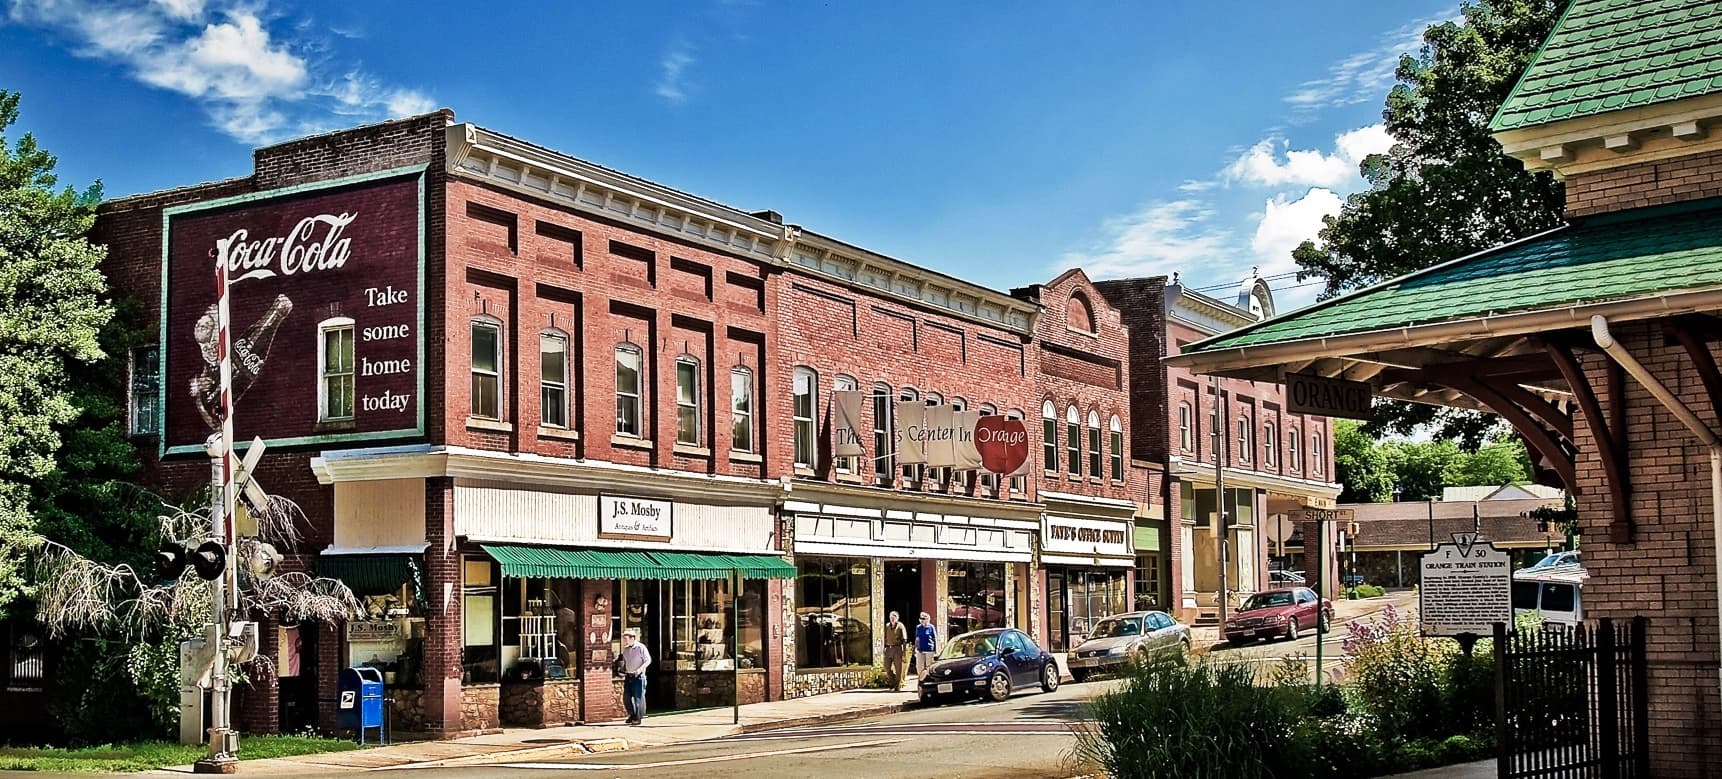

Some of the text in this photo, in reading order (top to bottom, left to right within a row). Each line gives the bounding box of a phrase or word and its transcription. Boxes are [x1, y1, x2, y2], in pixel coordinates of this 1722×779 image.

[227, 212, 357, 285] Coca-Cola
[364, 286, 408, 307] Take
[363, 324, 409, 341] some
[234, 339, 264, 375] Coca-Cola
[361, 357, 410, 376] home
[362, 390, 410, 412] today
[1293, 380, 1367, 413] ORANGE
[907, 425, 954, 442] Center
[959, 426, 972, 442] In
[612, 501, 661, 521] J.S. Mosby
[1305, 510, 1338, 520] SHORT
[1445, 549, 1487, 559] F 30
[1478, 561, 1506, 569] STATION
